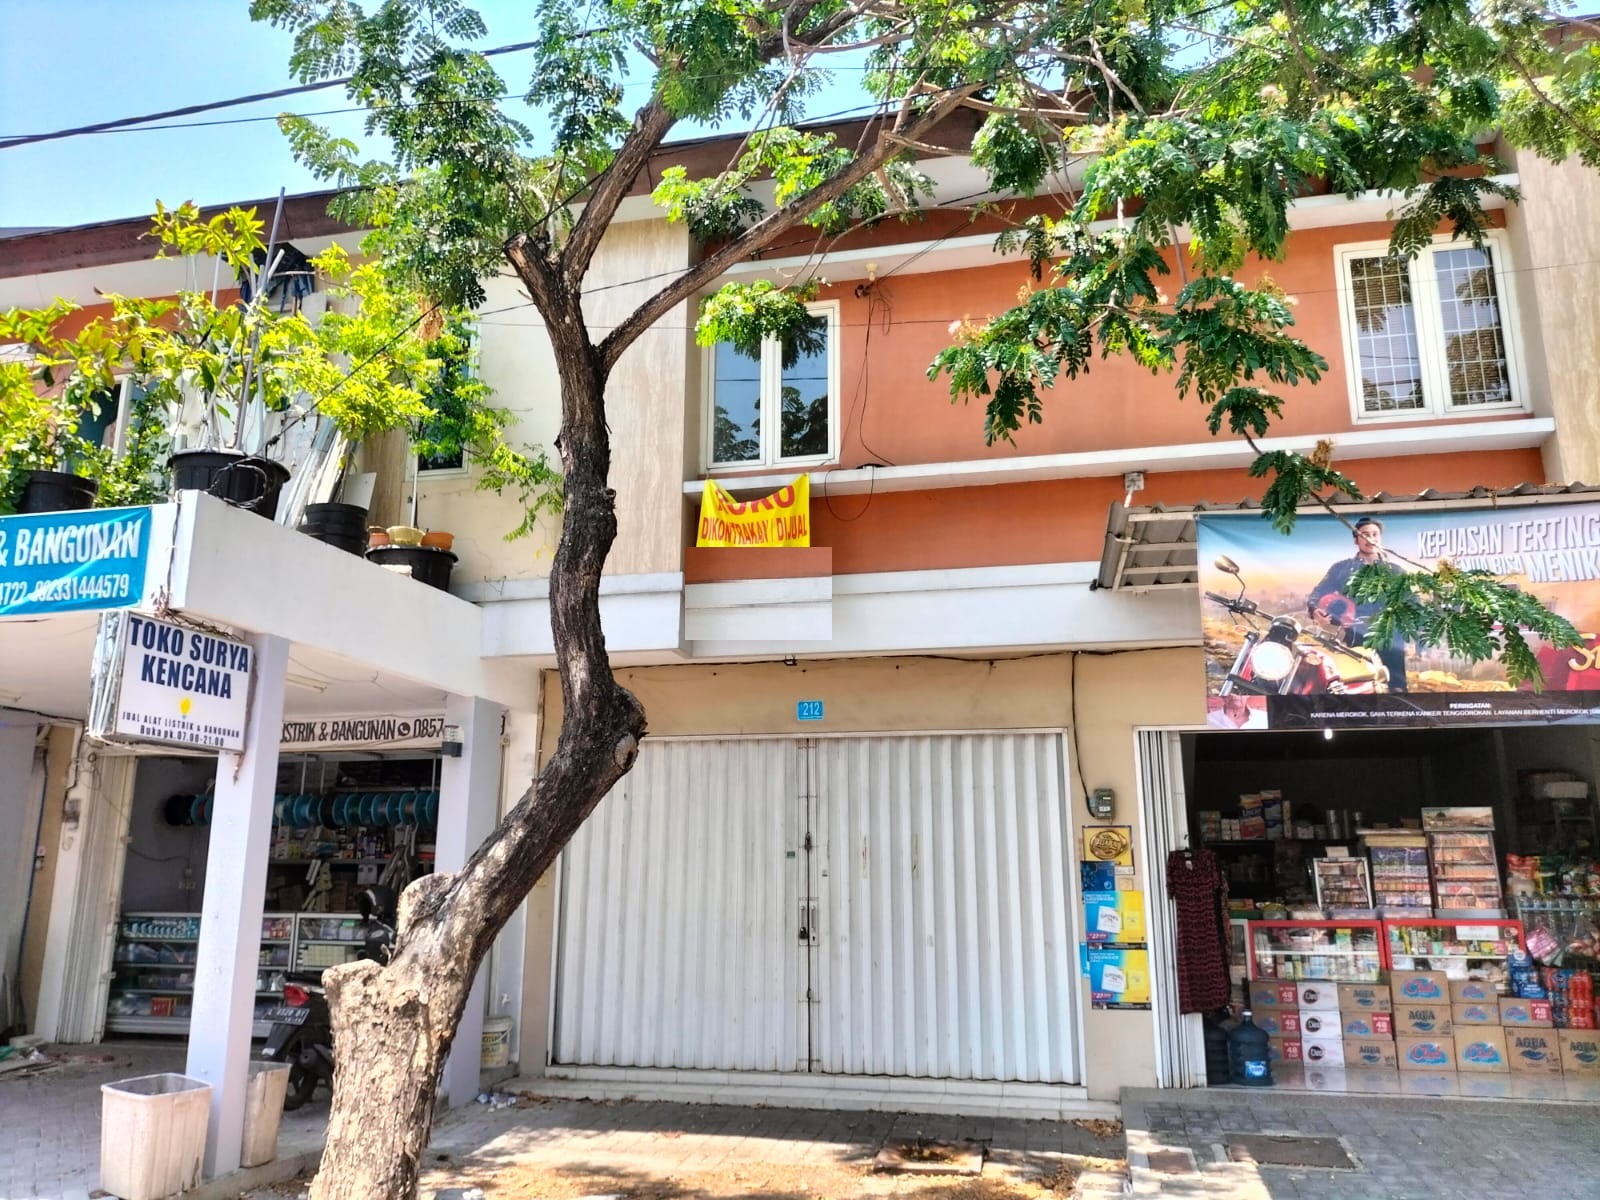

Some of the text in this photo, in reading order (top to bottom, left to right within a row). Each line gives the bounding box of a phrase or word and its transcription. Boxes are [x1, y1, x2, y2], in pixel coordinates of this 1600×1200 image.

[776, 513, 807, 541] DIJUAL
[14, 519, 142, 566] BANGUNAN
[1418, 524, 1503, 559] KEPUASAN
[1493, 554, 1526, 576] BISA
[130, 617, 248, 673] TOKO SURYA
[141, 654, 232, 699] KENCANA
[803, 702, 820, 716] 212
[122, 711, 141, 722] JUAL
[144, 714, 162, 727] ALAT
[165, 718, 194, 731] LISTRIK
[140, 725, 162, 738] Buka
[280, 718, 444, 743] ISTRIK & BANGUNAN 0857
[1408, 1010, 1436, 1021] AQUA
[1515, 1037, 1546, 1049] AQUA
[1569, 1041, 1597, 1052] AQUA
